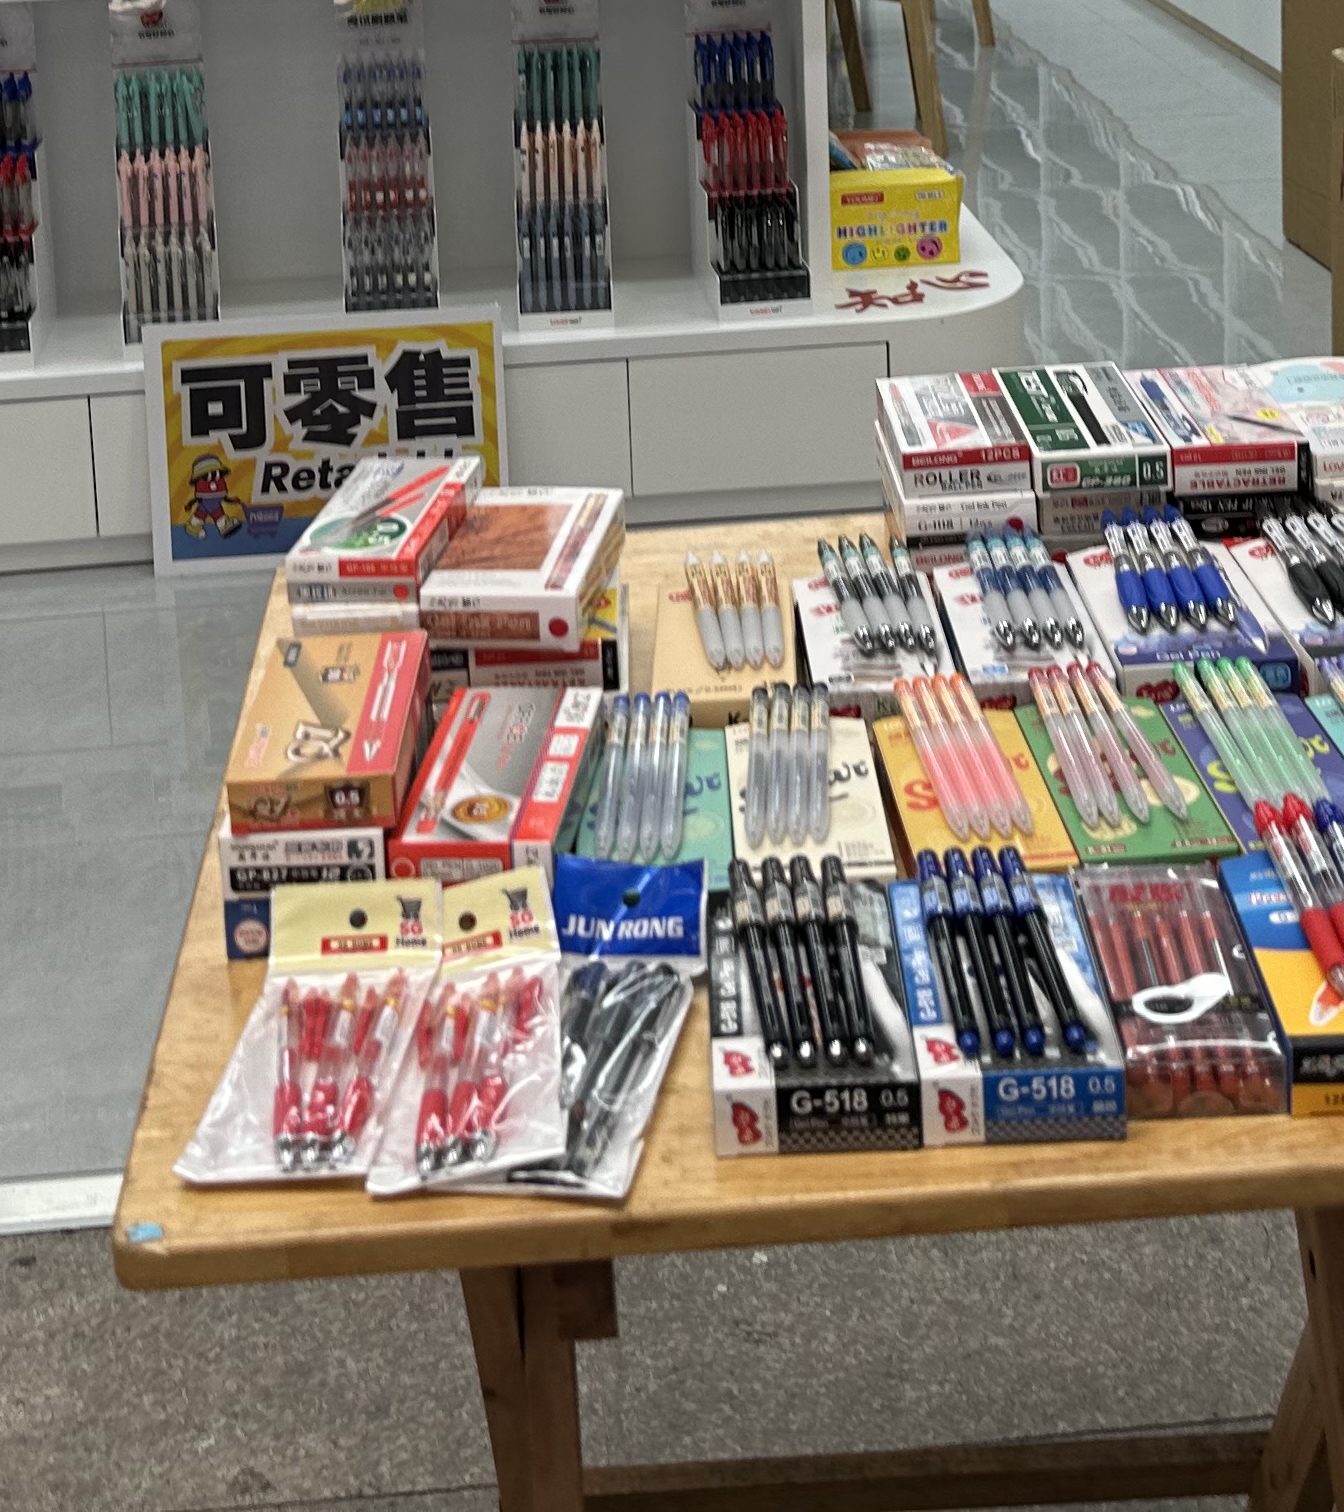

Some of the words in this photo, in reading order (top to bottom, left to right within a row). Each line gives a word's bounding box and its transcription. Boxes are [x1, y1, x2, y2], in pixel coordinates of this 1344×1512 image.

[836, 220, 949, 239] HIGHLIGHTER
[180, 347, 478, 450] 可零售
[913, 469, 981, 486] ROLLER
[1142, 461, 1164, 481] 0.5
[508, 924, 541, 940] Home
[561, 912, 612, 940] JUN
[616, 916, 684, 940] RONG
[395, 935, 428, 949] Home
[998, 1076, 1076, 1103] G-518
[1087, 1075, 1117, 1095] 0.5
[789, 1088, 868, 1116] G-518
[879, 1088, 909, 1108] 0.5
